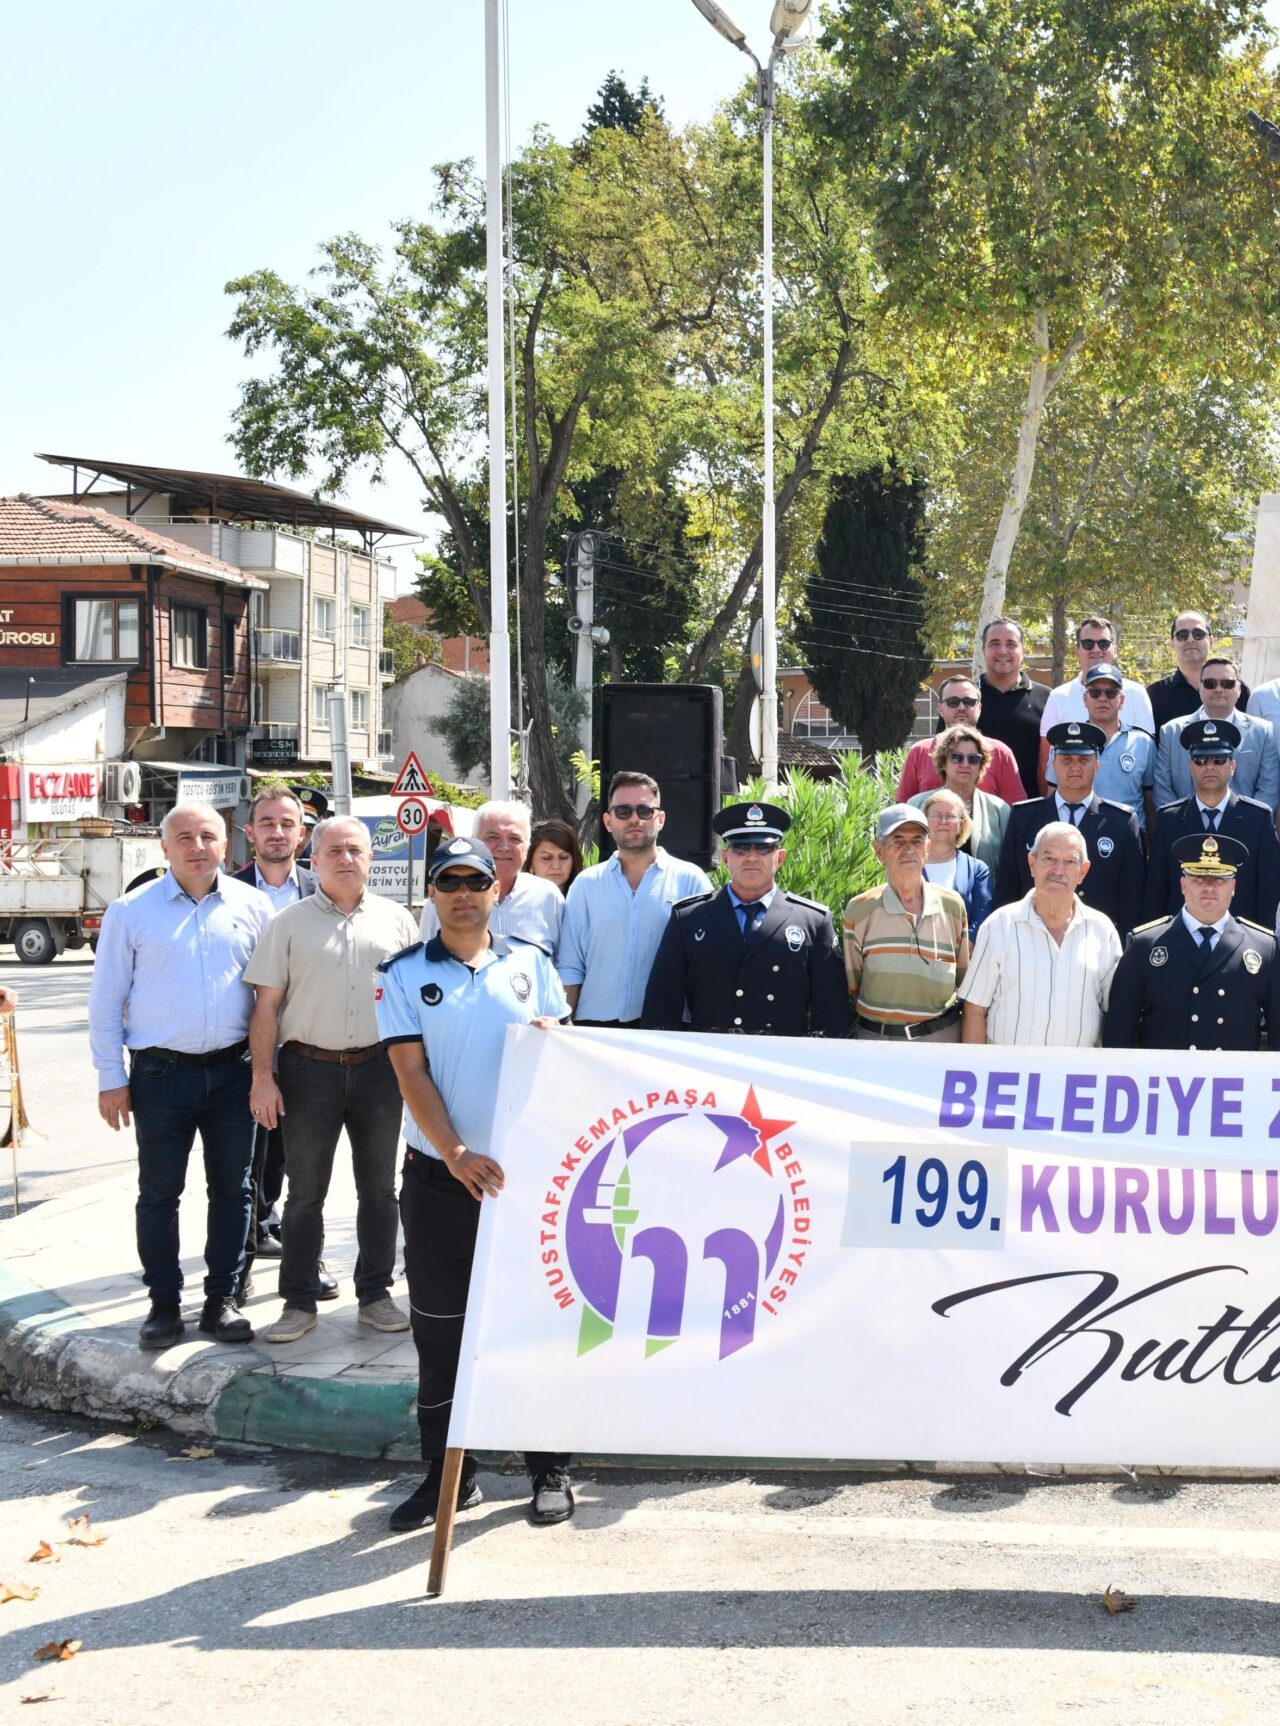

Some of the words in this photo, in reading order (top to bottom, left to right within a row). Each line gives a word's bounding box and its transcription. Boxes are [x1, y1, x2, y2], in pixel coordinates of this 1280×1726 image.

[270, 740, 294, 750] CSM
[29, 772, 96, 800] ECZANE
[403, 808, 422, 825] 30
[366, 876, 392, 887] İS'İN
[540, 1088, 718, 1309] MUSTAFAKEMALPAŞA
[761, 1142, 812, 1316] BELEDİYESİ
[882, 1157, 1000, 1231] 199.
[724, 1291, 755, 1320] 1881
